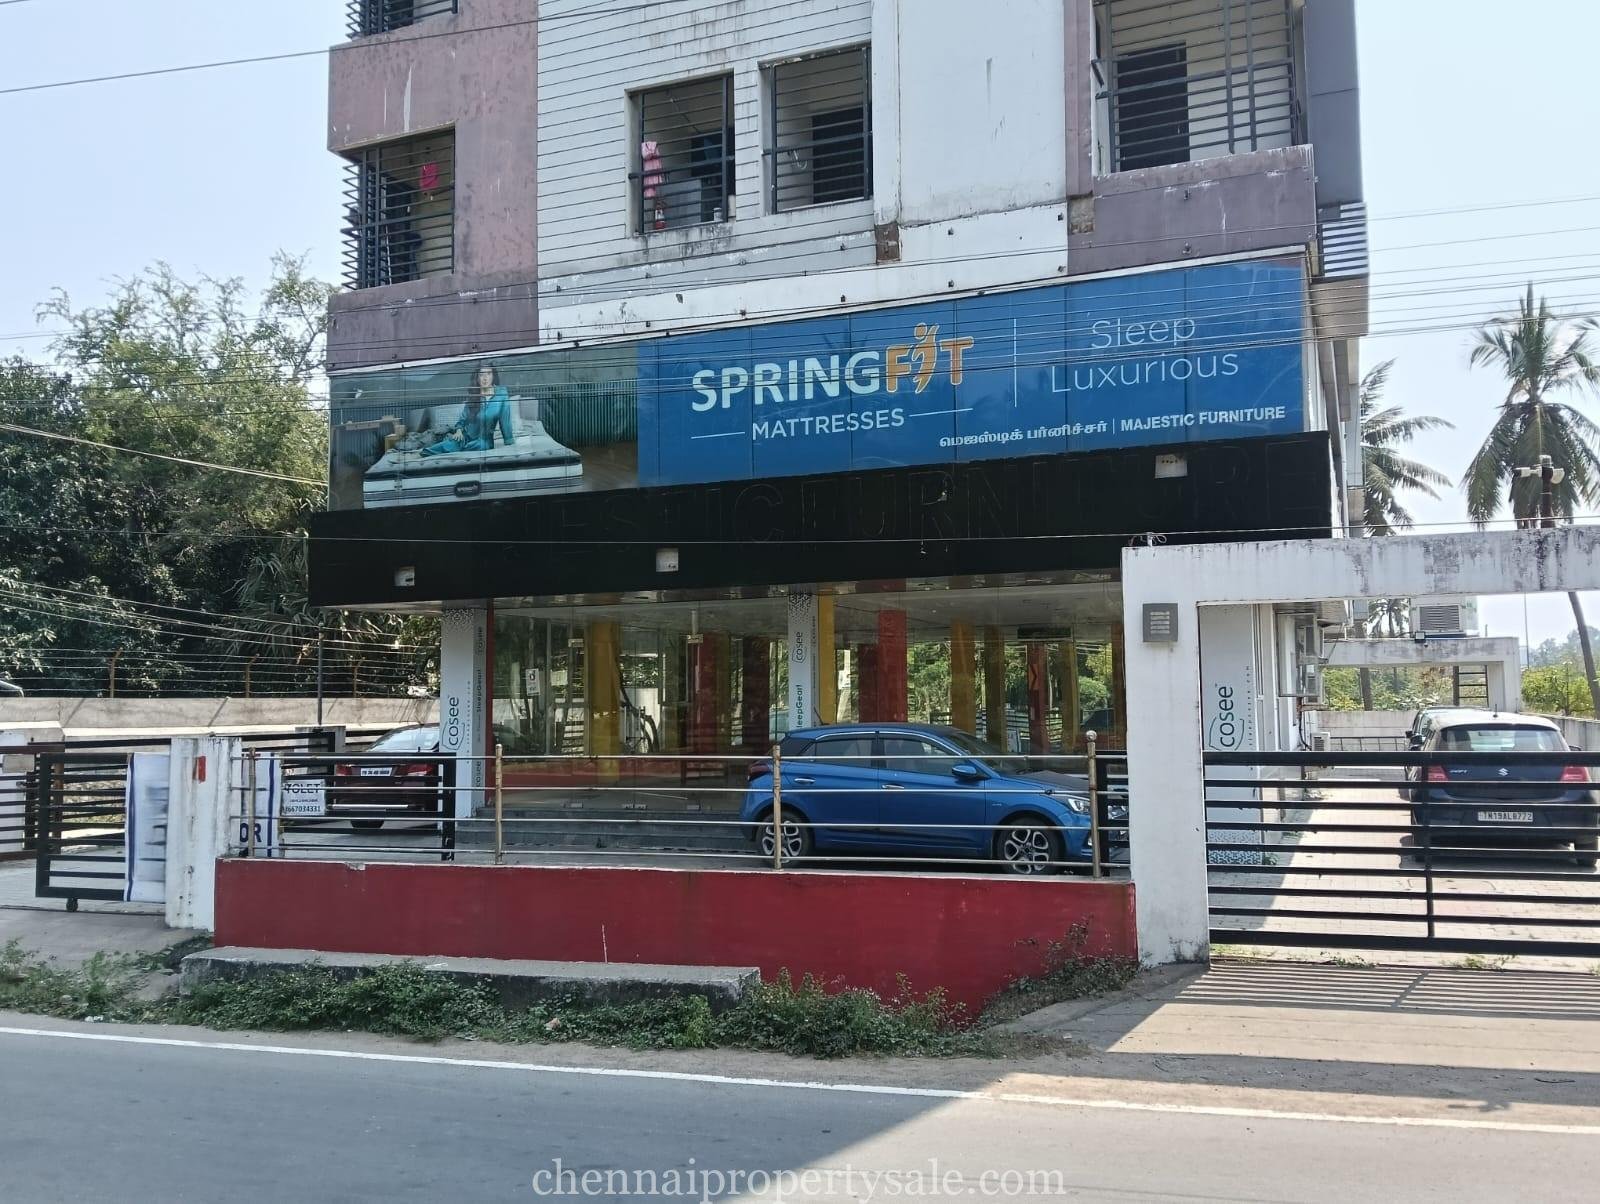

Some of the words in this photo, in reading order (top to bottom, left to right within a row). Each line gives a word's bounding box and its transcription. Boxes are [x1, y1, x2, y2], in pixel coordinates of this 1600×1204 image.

[1091, 316, 1196, 350] Sleep
[1051, 352, 1240, 394] Luxurious
[752, 408, 905, 441] MATTRESSES
[1120, 413, 1195, 432] MAJESTIC
[1198, 405, 1286, 426] FURNITURE
[448, 696, 460, 747] cosee
[1218, 686, 1234, 747] cosee
